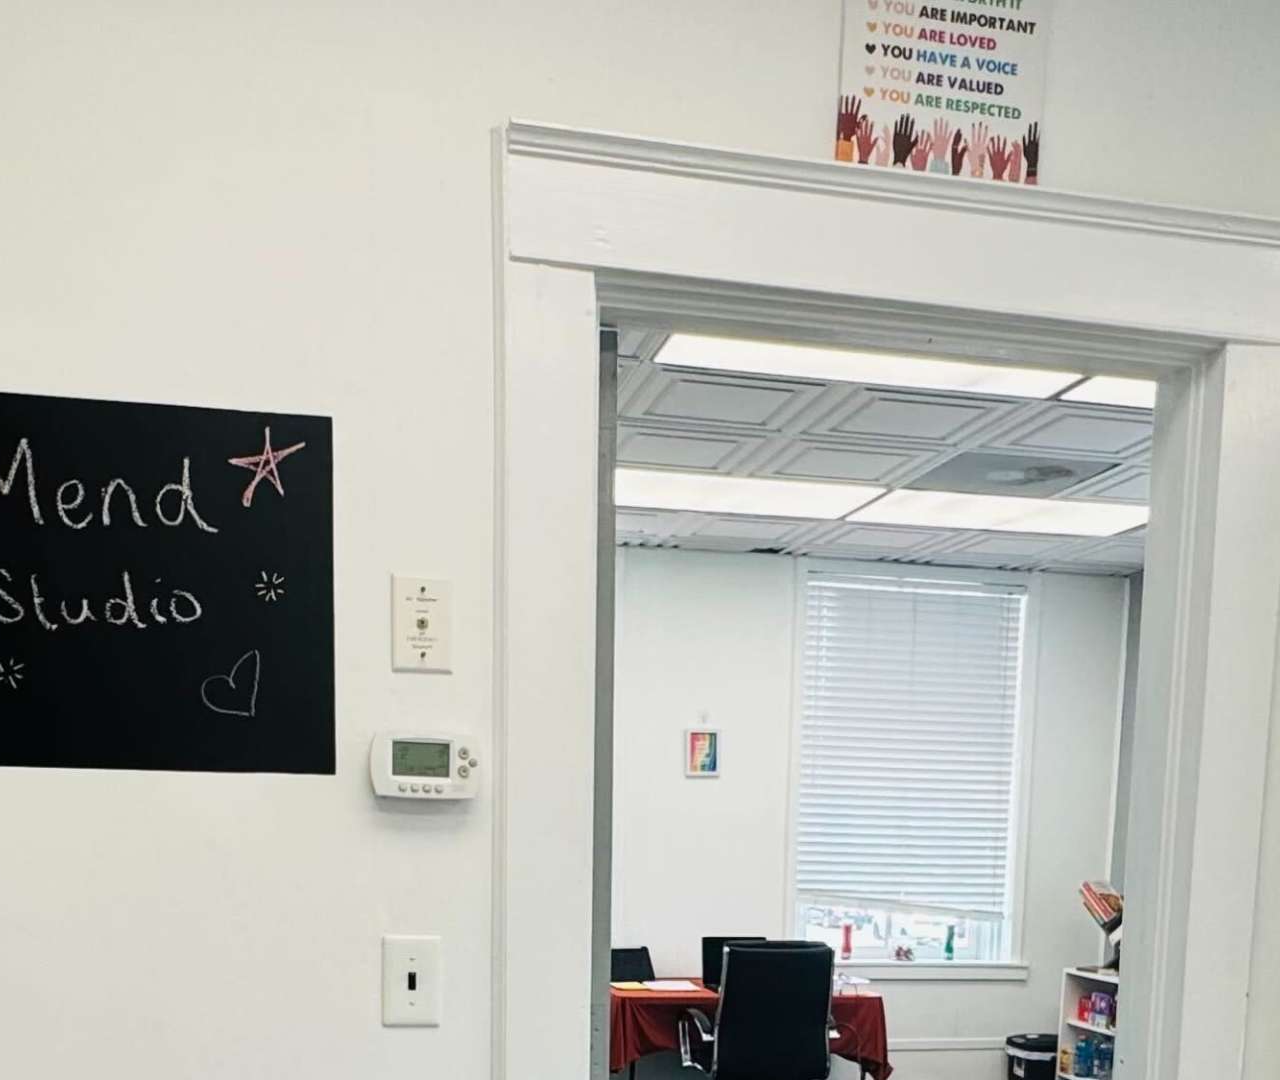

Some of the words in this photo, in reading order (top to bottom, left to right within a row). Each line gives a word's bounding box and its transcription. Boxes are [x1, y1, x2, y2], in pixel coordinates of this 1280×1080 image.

[883, 0, 915, 16] YOU
[919, 5, 947, 22] ARE
[950, 10, 1036, 35] IMPORTANT
[883, 22, 914, 38] YOU
[918, 28, 946, 44] ARE
[949, 32, 997, 51] LOVED
[881, 44, 913, 60] YOU
[916, 49, 957, 68] HAVE
[960, 57, 971, 69] A
[976, 58, 1018, 76] VOICE
[880, 65, 912, 82] YOU
[915, 72, 943, 87] ARE
[947, 76, 1004, 95] VALUED
[879, 87, 911, 104] YOU
[914, 93, 942, 109] ARE
[945, 98, 1021, 120] RESPECTED
